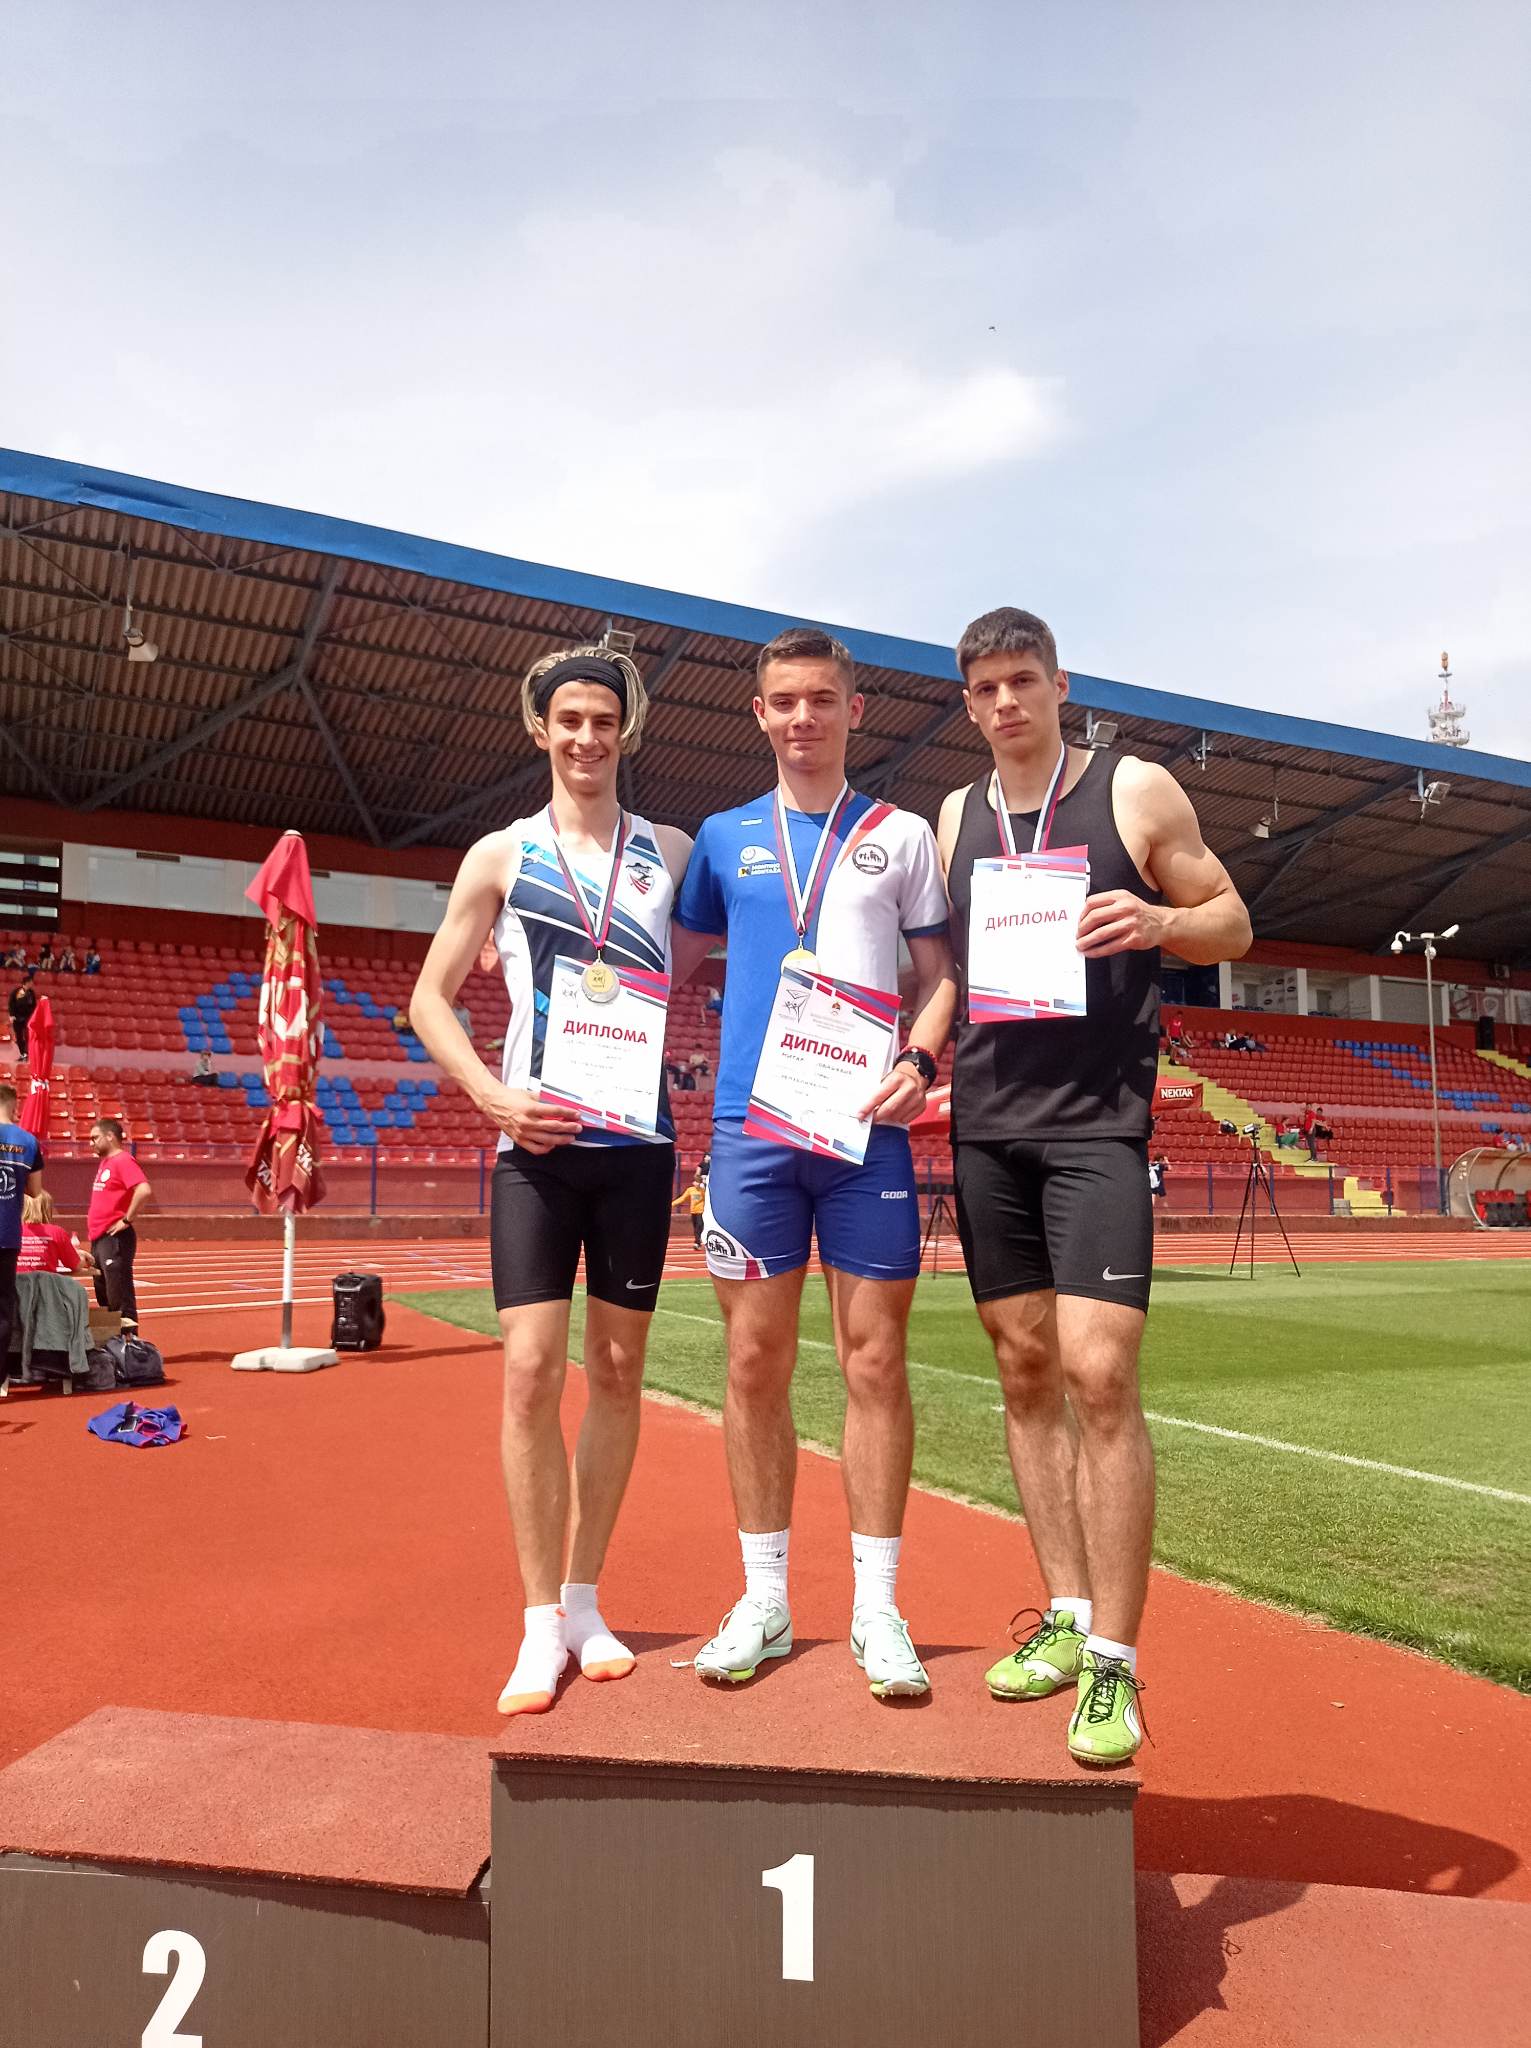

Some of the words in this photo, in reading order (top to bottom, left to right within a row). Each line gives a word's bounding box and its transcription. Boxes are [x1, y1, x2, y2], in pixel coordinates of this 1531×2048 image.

[985, 909, 1069, 931] ДИПЛОМА
[563, 1020, 648, 1044] ДИПЛОМА
[780, 1033, 868, 1068] ДИПЛОМА
[1160, 1088, 1194, 1099] NEKTAR
[762, 1853, 815, 1982] 1
[141, 1929, 207, 2048] 2
